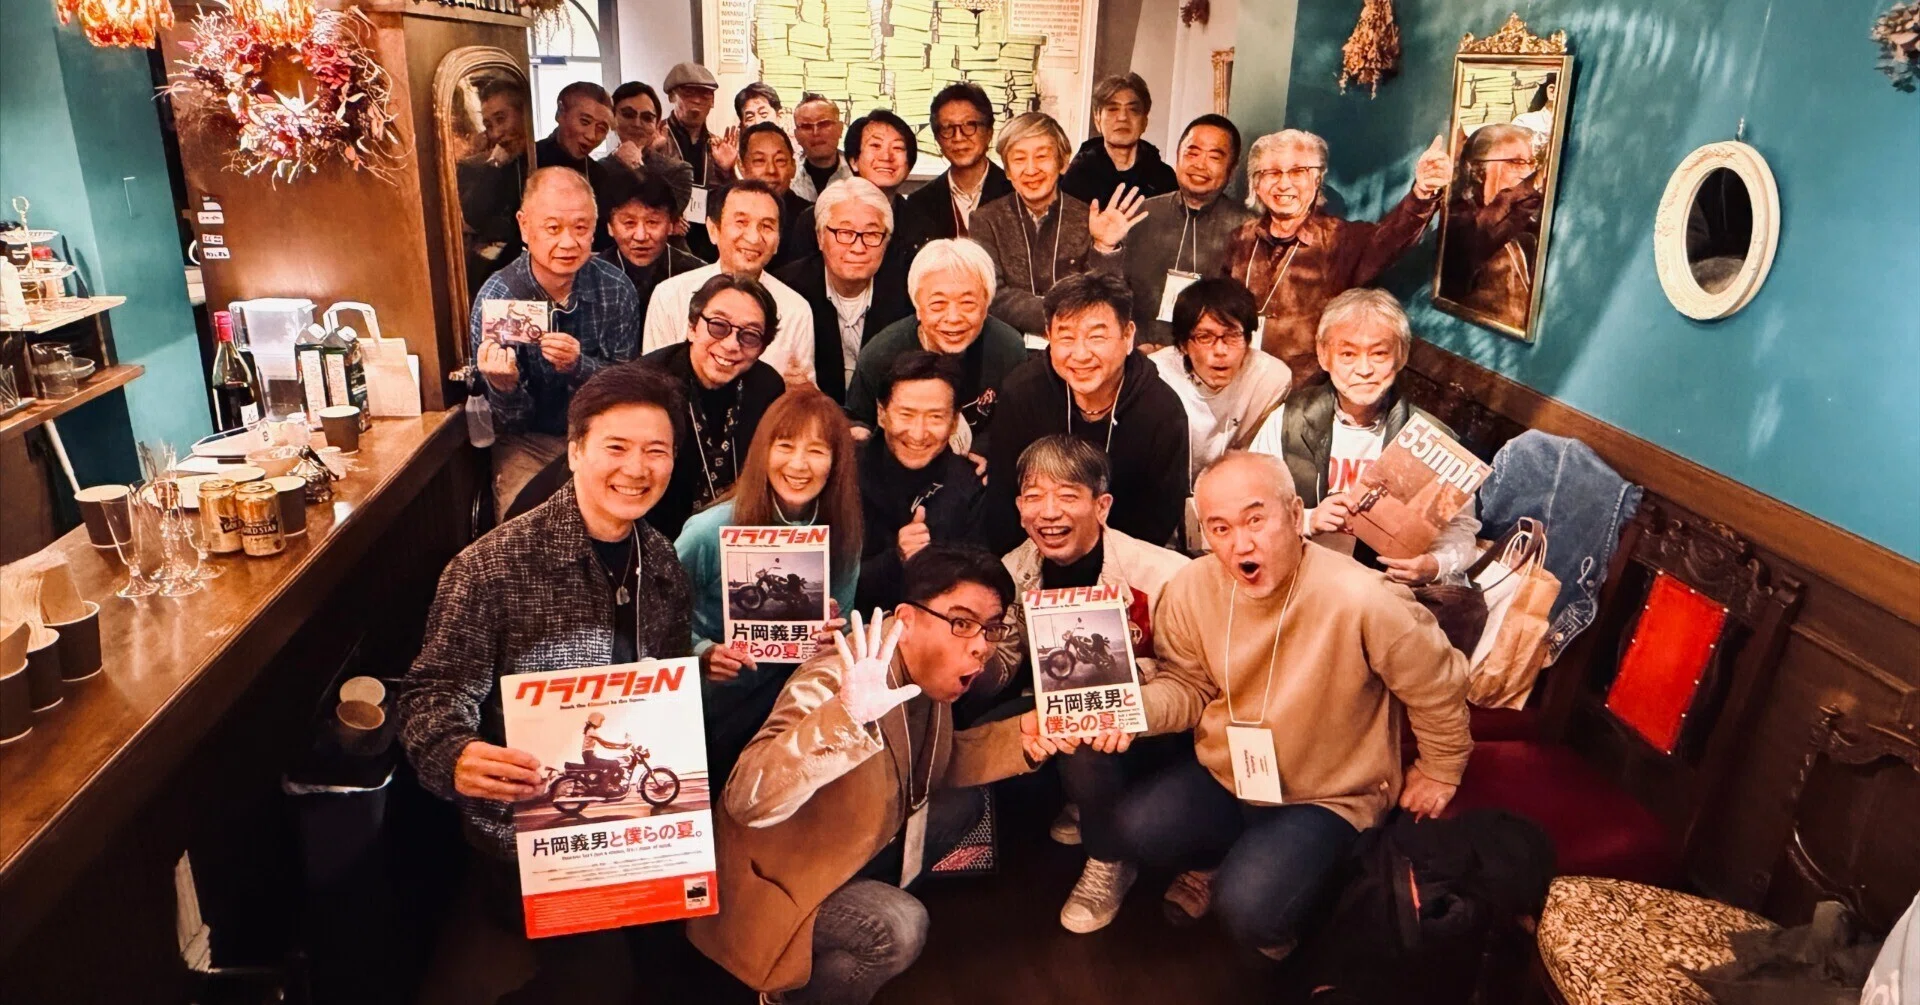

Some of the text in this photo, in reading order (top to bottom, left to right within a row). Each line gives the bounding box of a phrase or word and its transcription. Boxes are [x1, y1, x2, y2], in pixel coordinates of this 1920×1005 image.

[1397, 417, 1482, 494] 55mph
[1046, 688, 1136, 715] 片岡義男と
